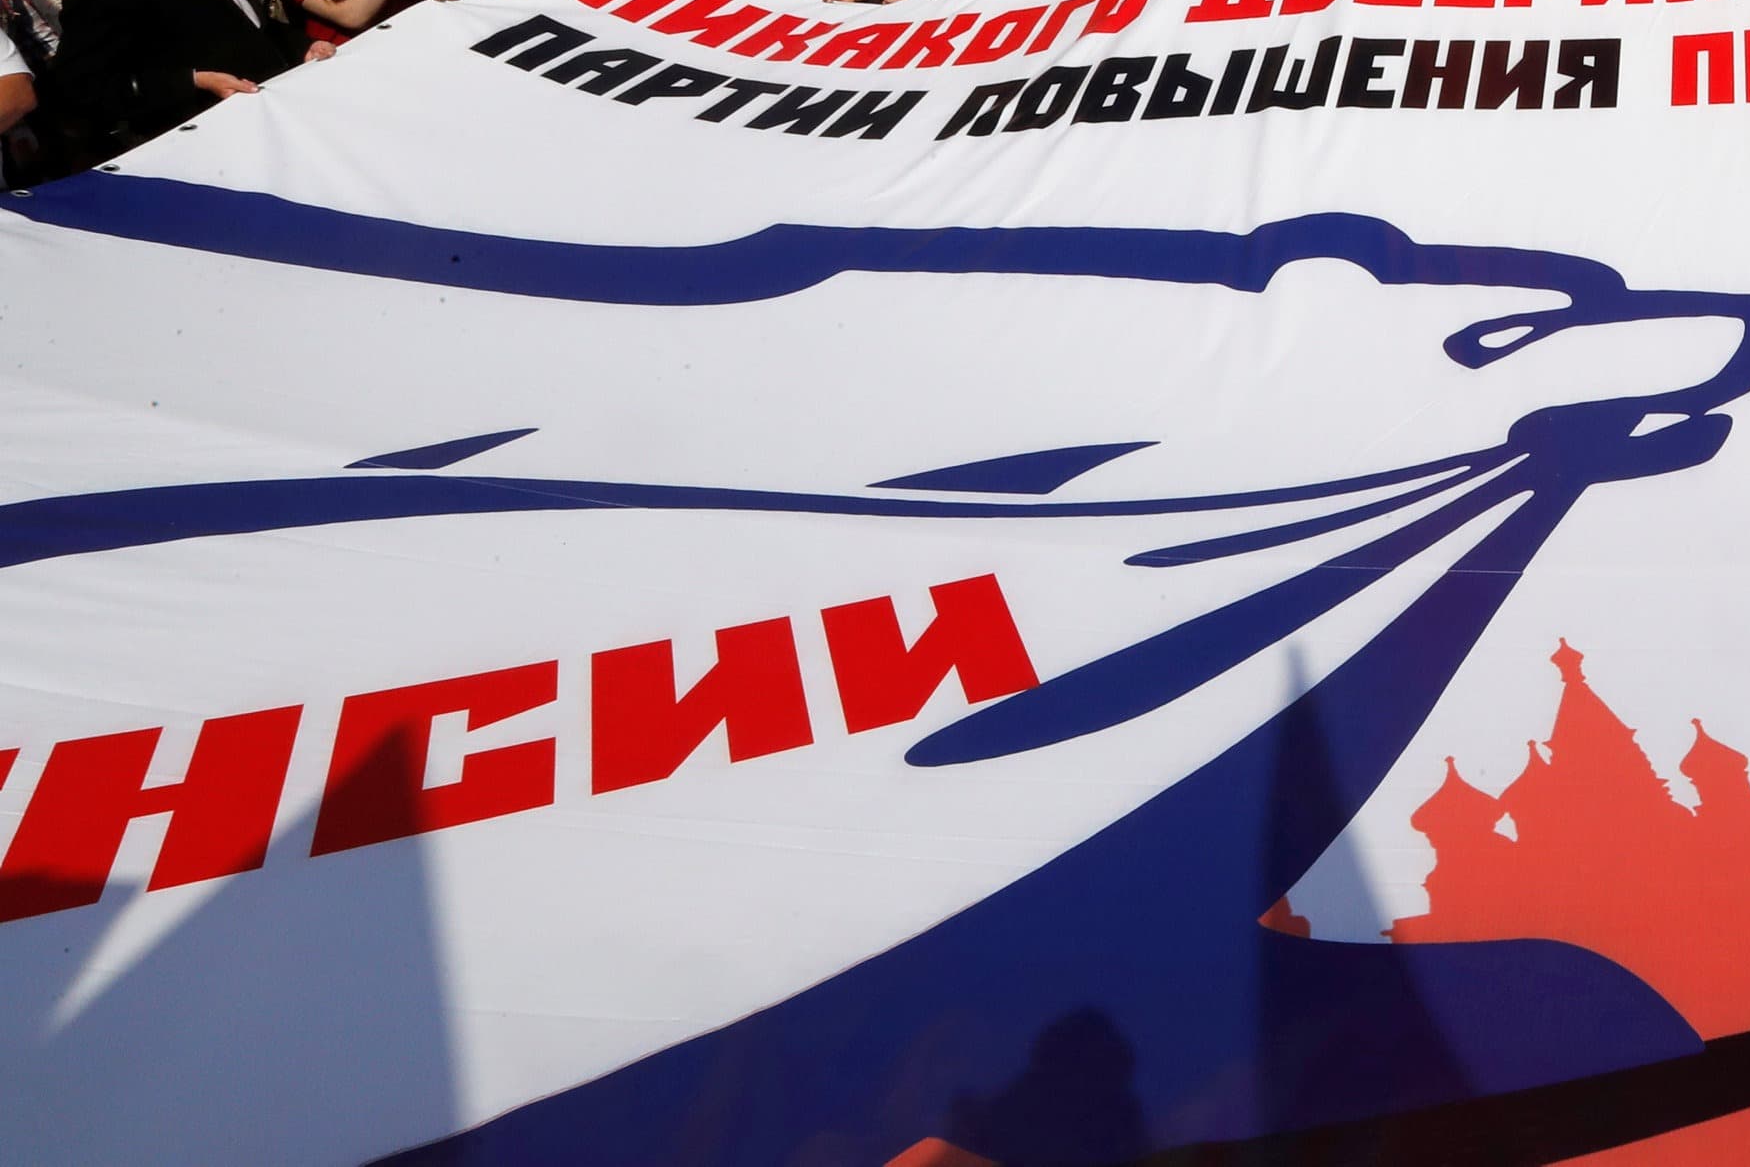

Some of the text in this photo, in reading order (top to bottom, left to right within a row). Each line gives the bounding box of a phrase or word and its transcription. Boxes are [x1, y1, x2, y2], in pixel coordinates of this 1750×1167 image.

[470, 13, 928, 140] ПАРТИИ
[934, 35, 1622, 142] ПОВЫШЕНИЯ
[0, 572, 1041, 924] НСИИ
